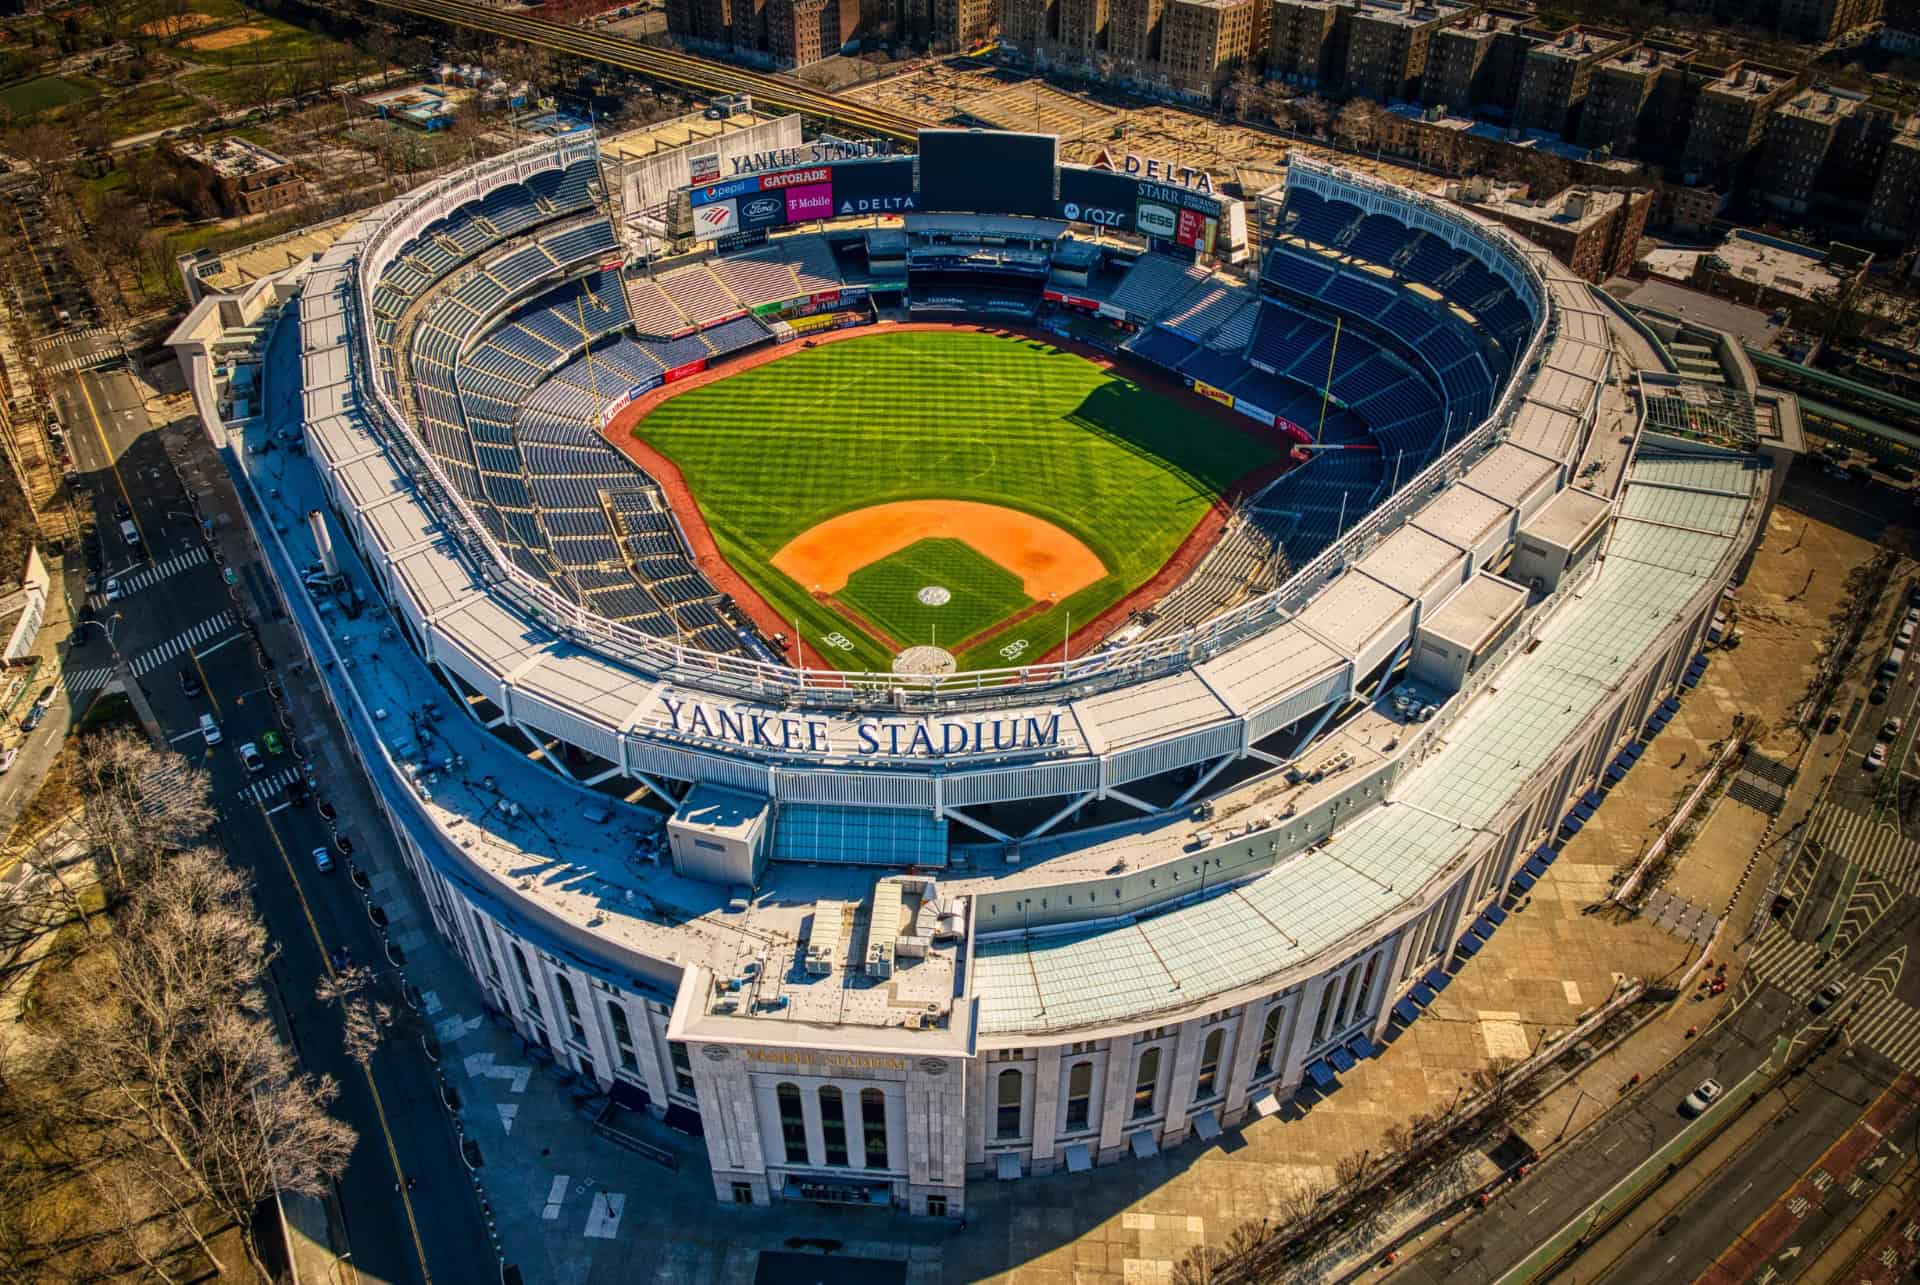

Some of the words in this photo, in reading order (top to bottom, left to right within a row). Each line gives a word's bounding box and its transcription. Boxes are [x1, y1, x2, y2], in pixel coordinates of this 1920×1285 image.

[730, 147, 801, 176] YANKEE
[811, 138, 893, 163] STADIUM
[763, 169, 828, 188] GATORADE
[1124, 154, 1213, 195] DELTA
[717, 181, 745, 199] pepsi
[1137, 183, 1180, 205] STARR
[749, 200, 776, 216] Ford
[858, 196, 915, 212] DELTA
[1084, 206, 1126, 227] razr
[1140, 209, 1175, 229] HESS
[660, 697, 831, 753] YANKEE
[856, 710, 1063, 757] STADIUM
